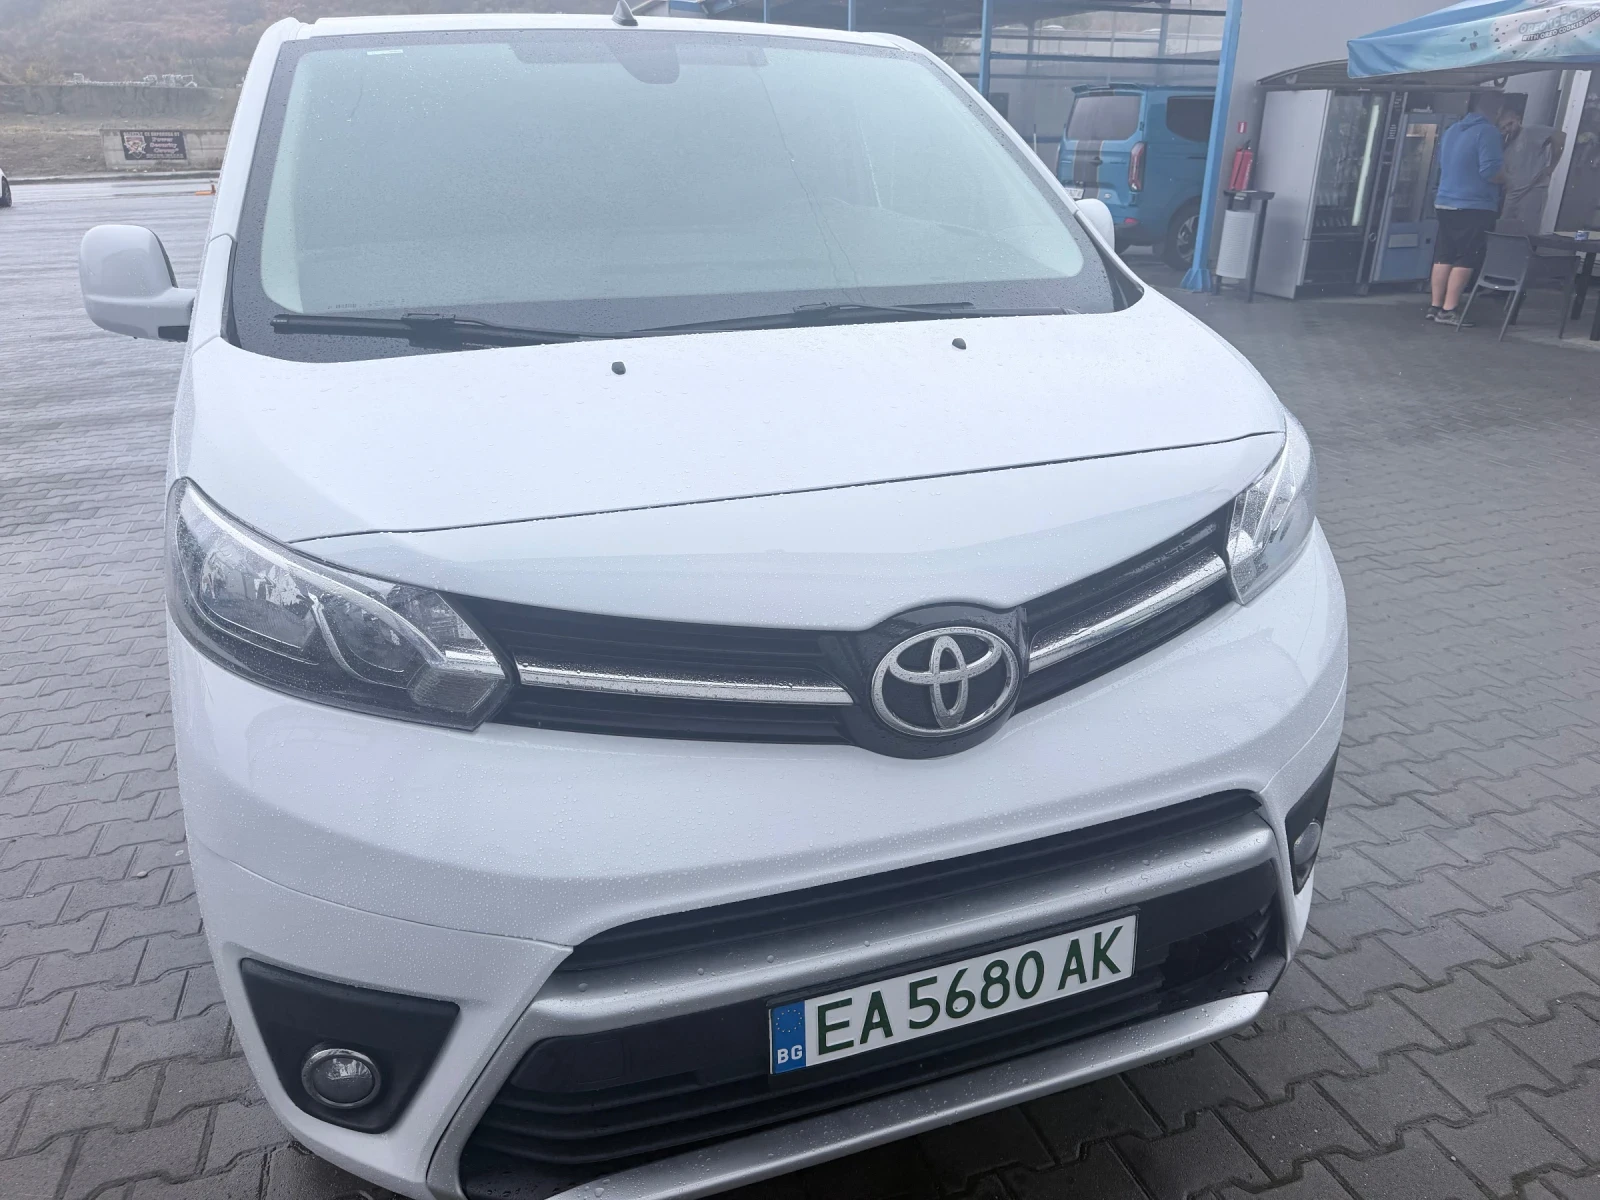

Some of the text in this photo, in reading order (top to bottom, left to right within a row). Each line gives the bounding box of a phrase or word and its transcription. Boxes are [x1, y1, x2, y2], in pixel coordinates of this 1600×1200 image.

[1519, 21, 1548, 34] OREO
[1540, 28, 1558, 39] OREO
[1559, 20, 1584, 34] COOKIE
[817, 925, 1124, 1056] EA 5680 AK
[777, 1045, 803, 1064] BG
